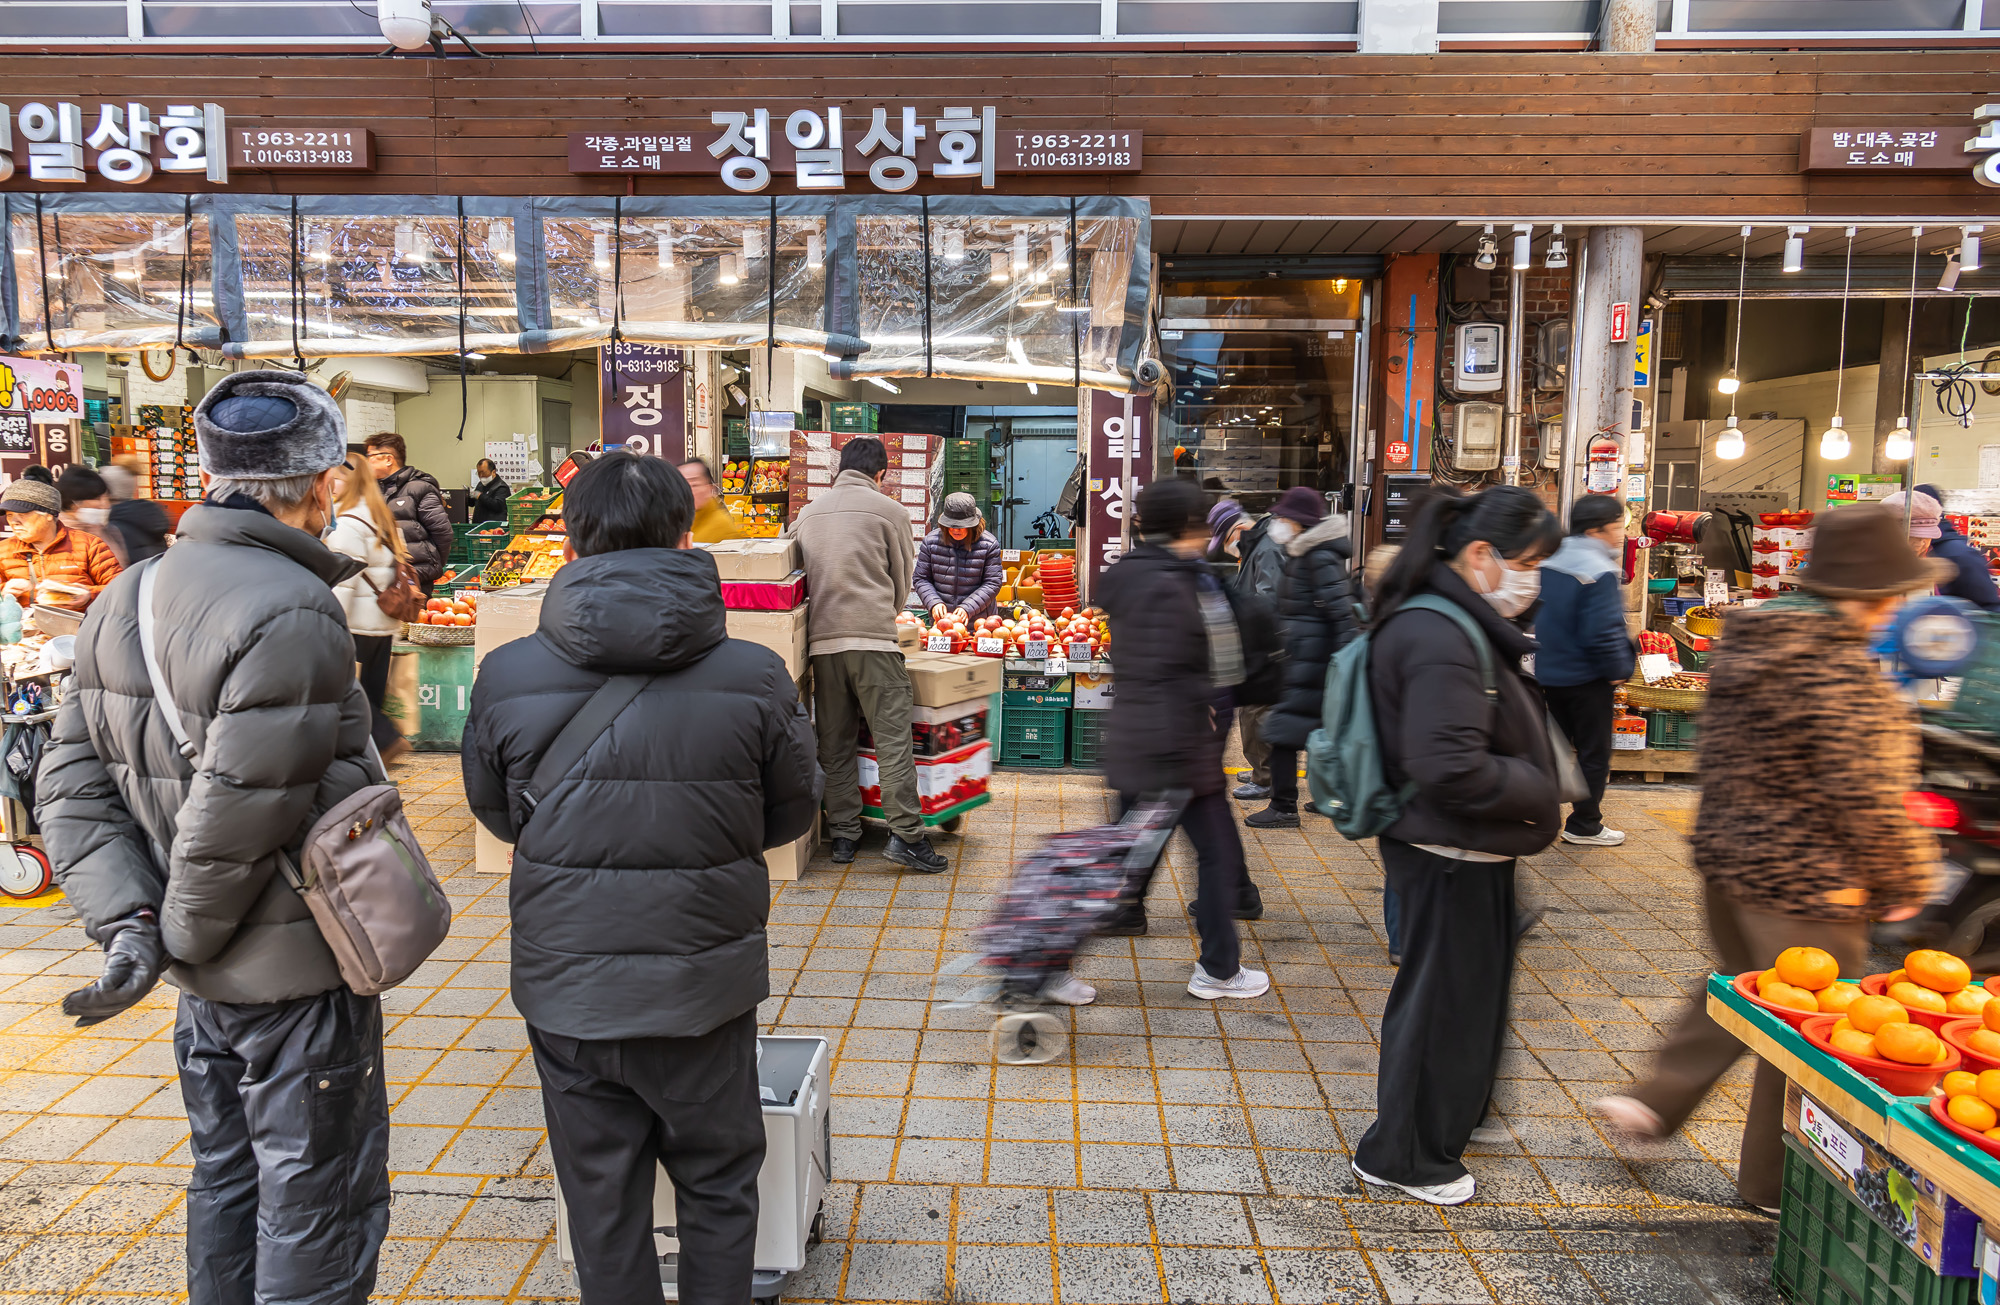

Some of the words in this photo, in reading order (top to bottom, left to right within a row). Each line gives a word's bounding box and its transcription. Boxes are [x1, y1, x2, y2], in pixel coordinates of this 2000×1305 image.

[584, 136, 692, 153] 각종.과일일절
[1832, 131, 1938, 148] 밤.대추.곶감
[706, 106, 996, 192] 정일상회
[604, 359, 680, 374] 00-6313-9183
[17, 381, 78, 413] 1,000원
